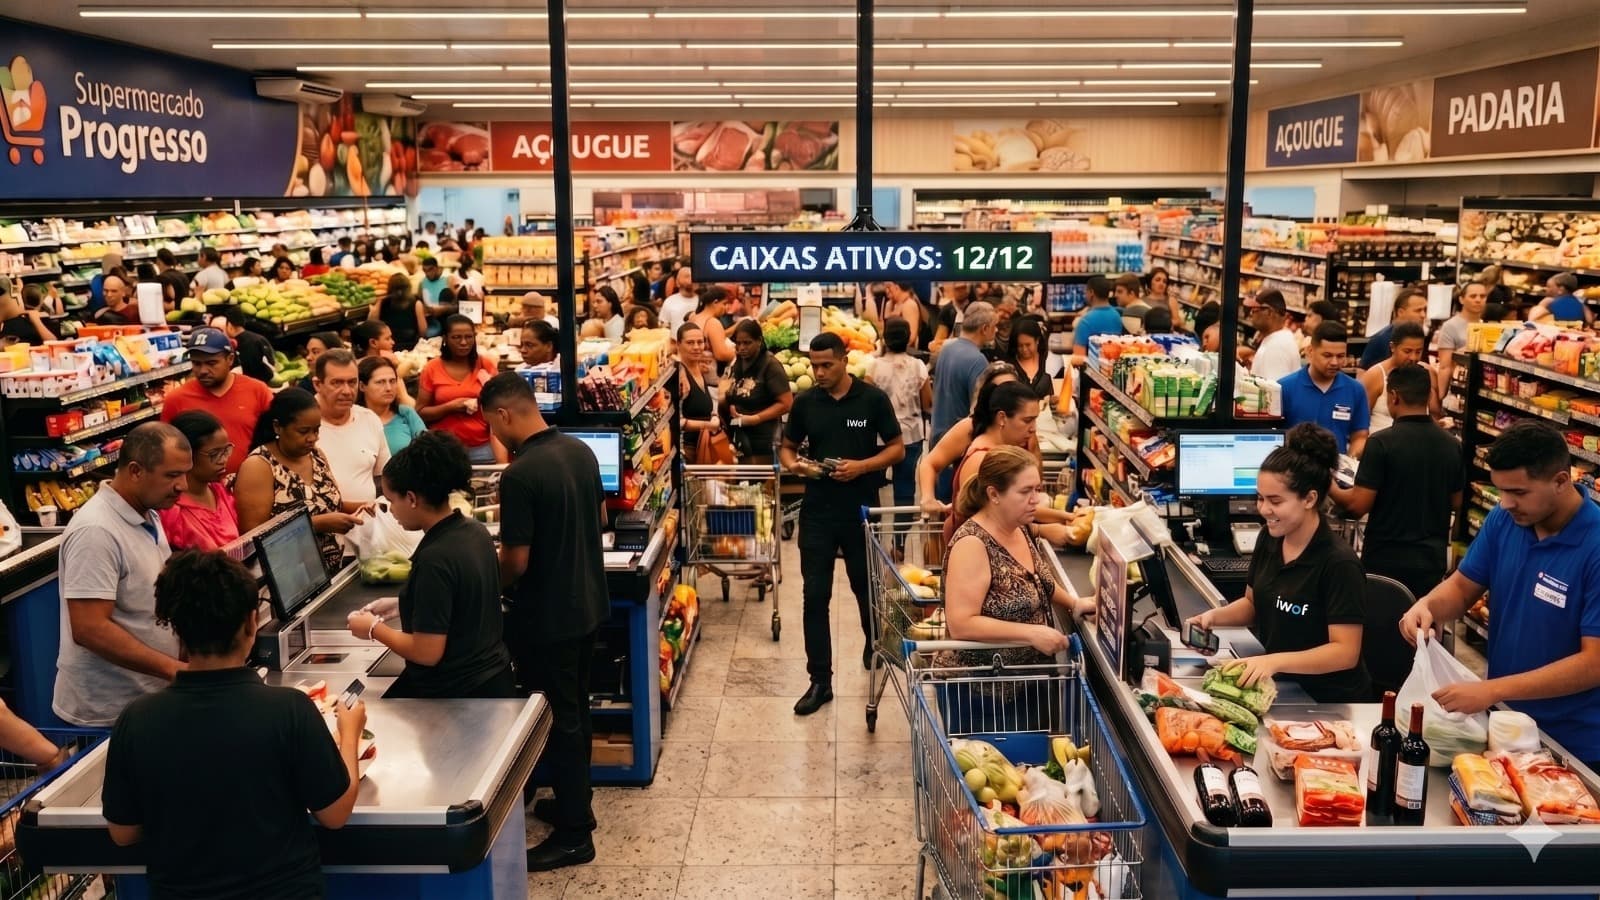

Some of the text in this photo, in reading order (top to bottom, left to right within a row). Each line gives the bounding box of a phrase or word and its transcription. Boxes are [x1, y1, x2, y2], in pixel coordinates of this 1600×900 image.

[75, 72, 204, 119] Supermercado
[1448, 81, 1565, 135] PADARIA
[60, 104, 207, 174] Progresso
[511, 134, 651, 165] AÇUGUE
[1275, 115, 1344, 158] AÇOUGUE
[709, 245, 1033, 271] CAIXAS ATIVOS: 12/12
